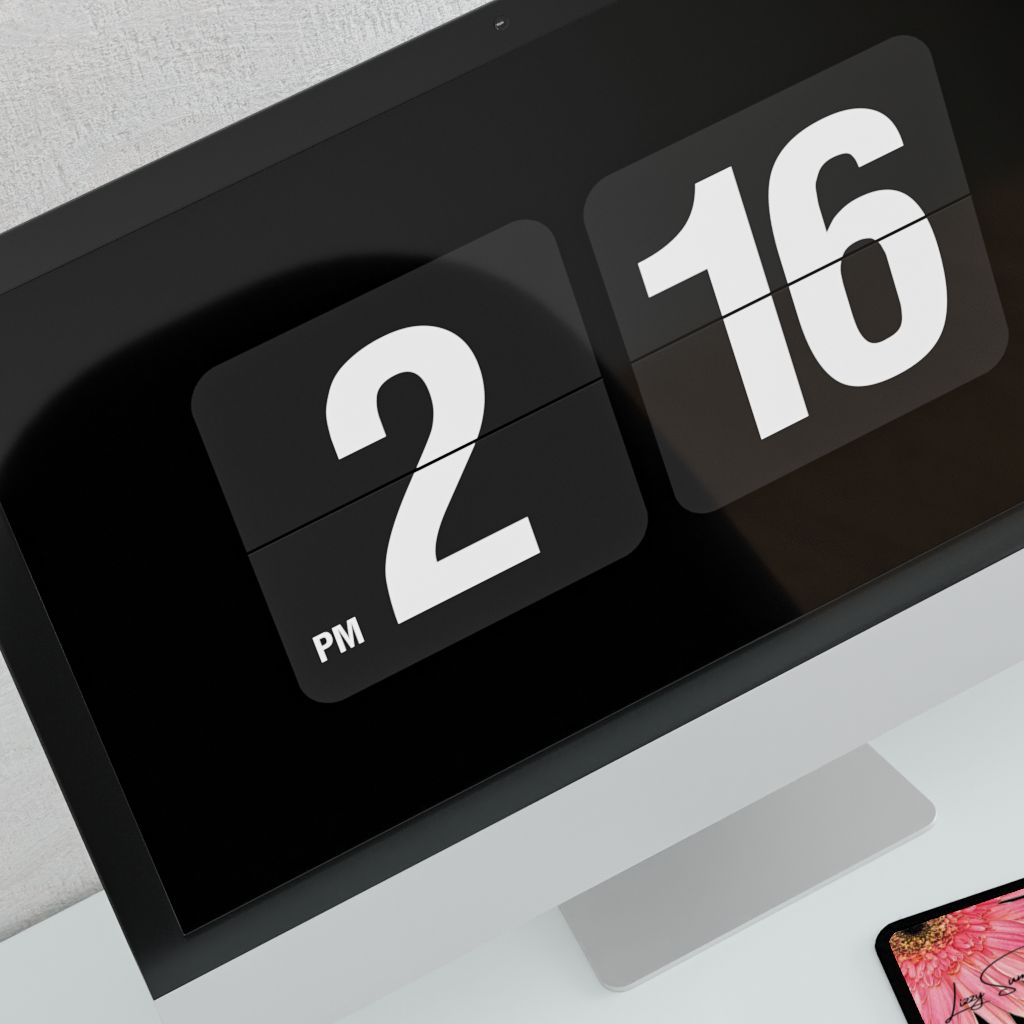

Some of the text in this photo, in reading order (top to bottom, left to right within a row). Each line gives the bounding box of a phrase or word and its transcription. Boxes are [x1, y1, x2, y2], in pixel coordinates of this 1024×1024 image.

[325, 108, 948, 625] 2 16
[311, 616, 365, 664] PM
[944, 982, 992, 1024] Lizzy
